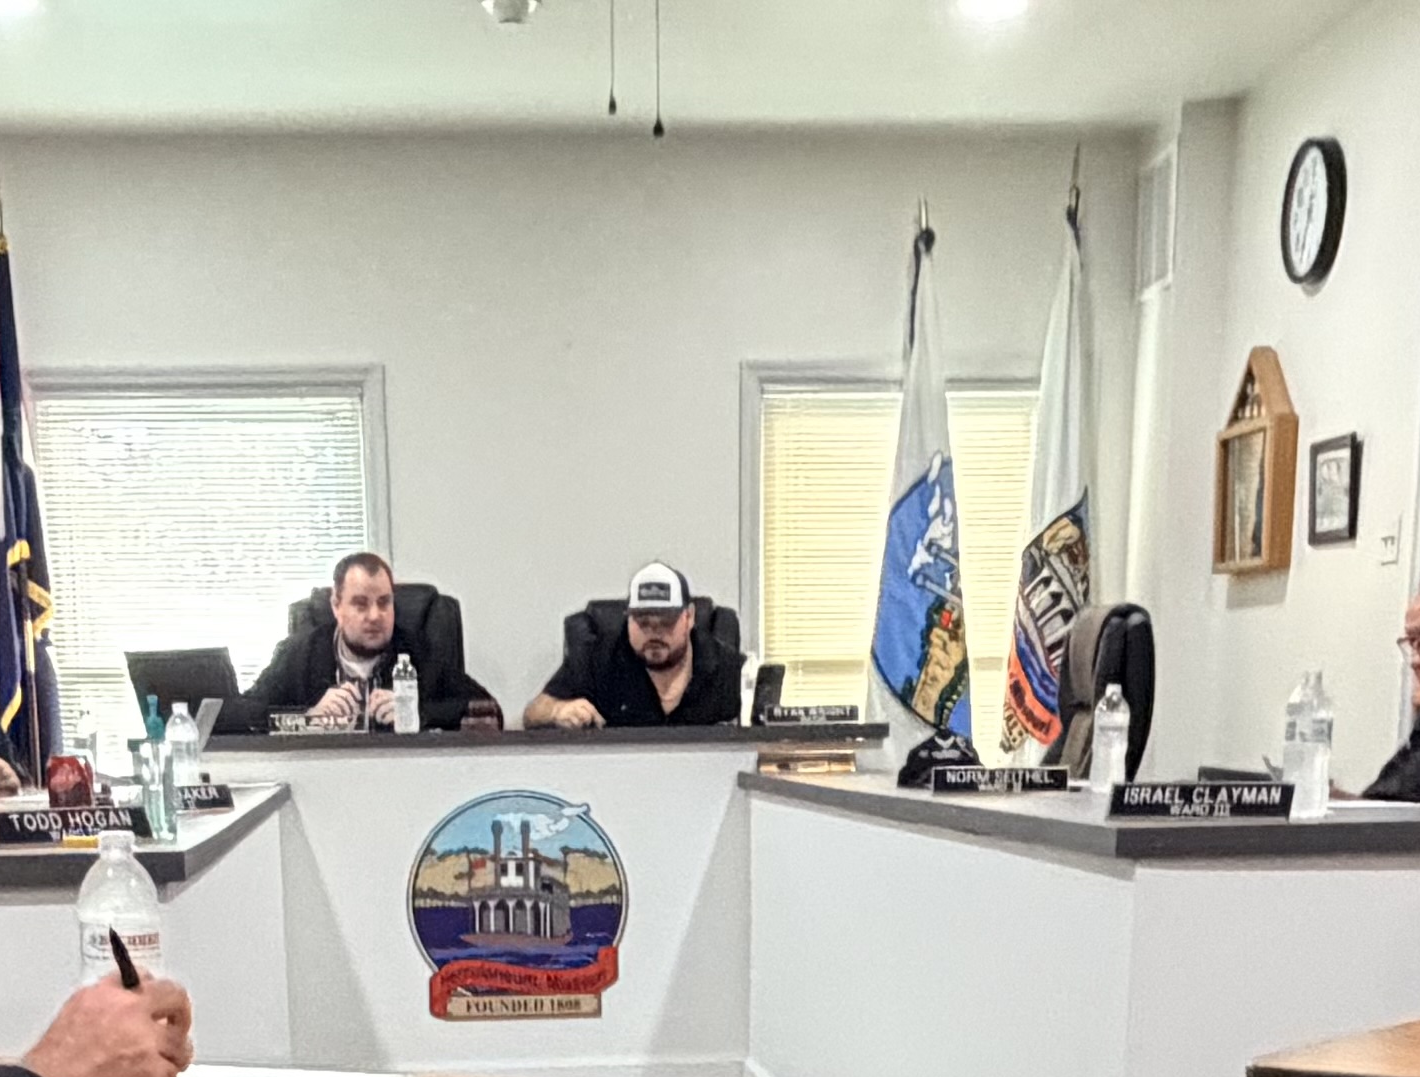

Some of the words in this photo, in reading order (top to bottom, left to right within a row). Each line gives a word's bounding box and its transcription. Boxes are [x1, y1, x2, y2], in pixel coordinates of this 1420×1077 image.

[946, 769, 988, 784] NORM
[1123, 786, 1185, 805] ISRAEL
[1192, 786, 1282, 805] CLAYMAN
[1169, 803, 1210, 816] WARD
[9, 813, 63, 832] TODD
[68, 810, 133, 828] HOGAN
[466, 999, 545, 1014] FOUNDED
